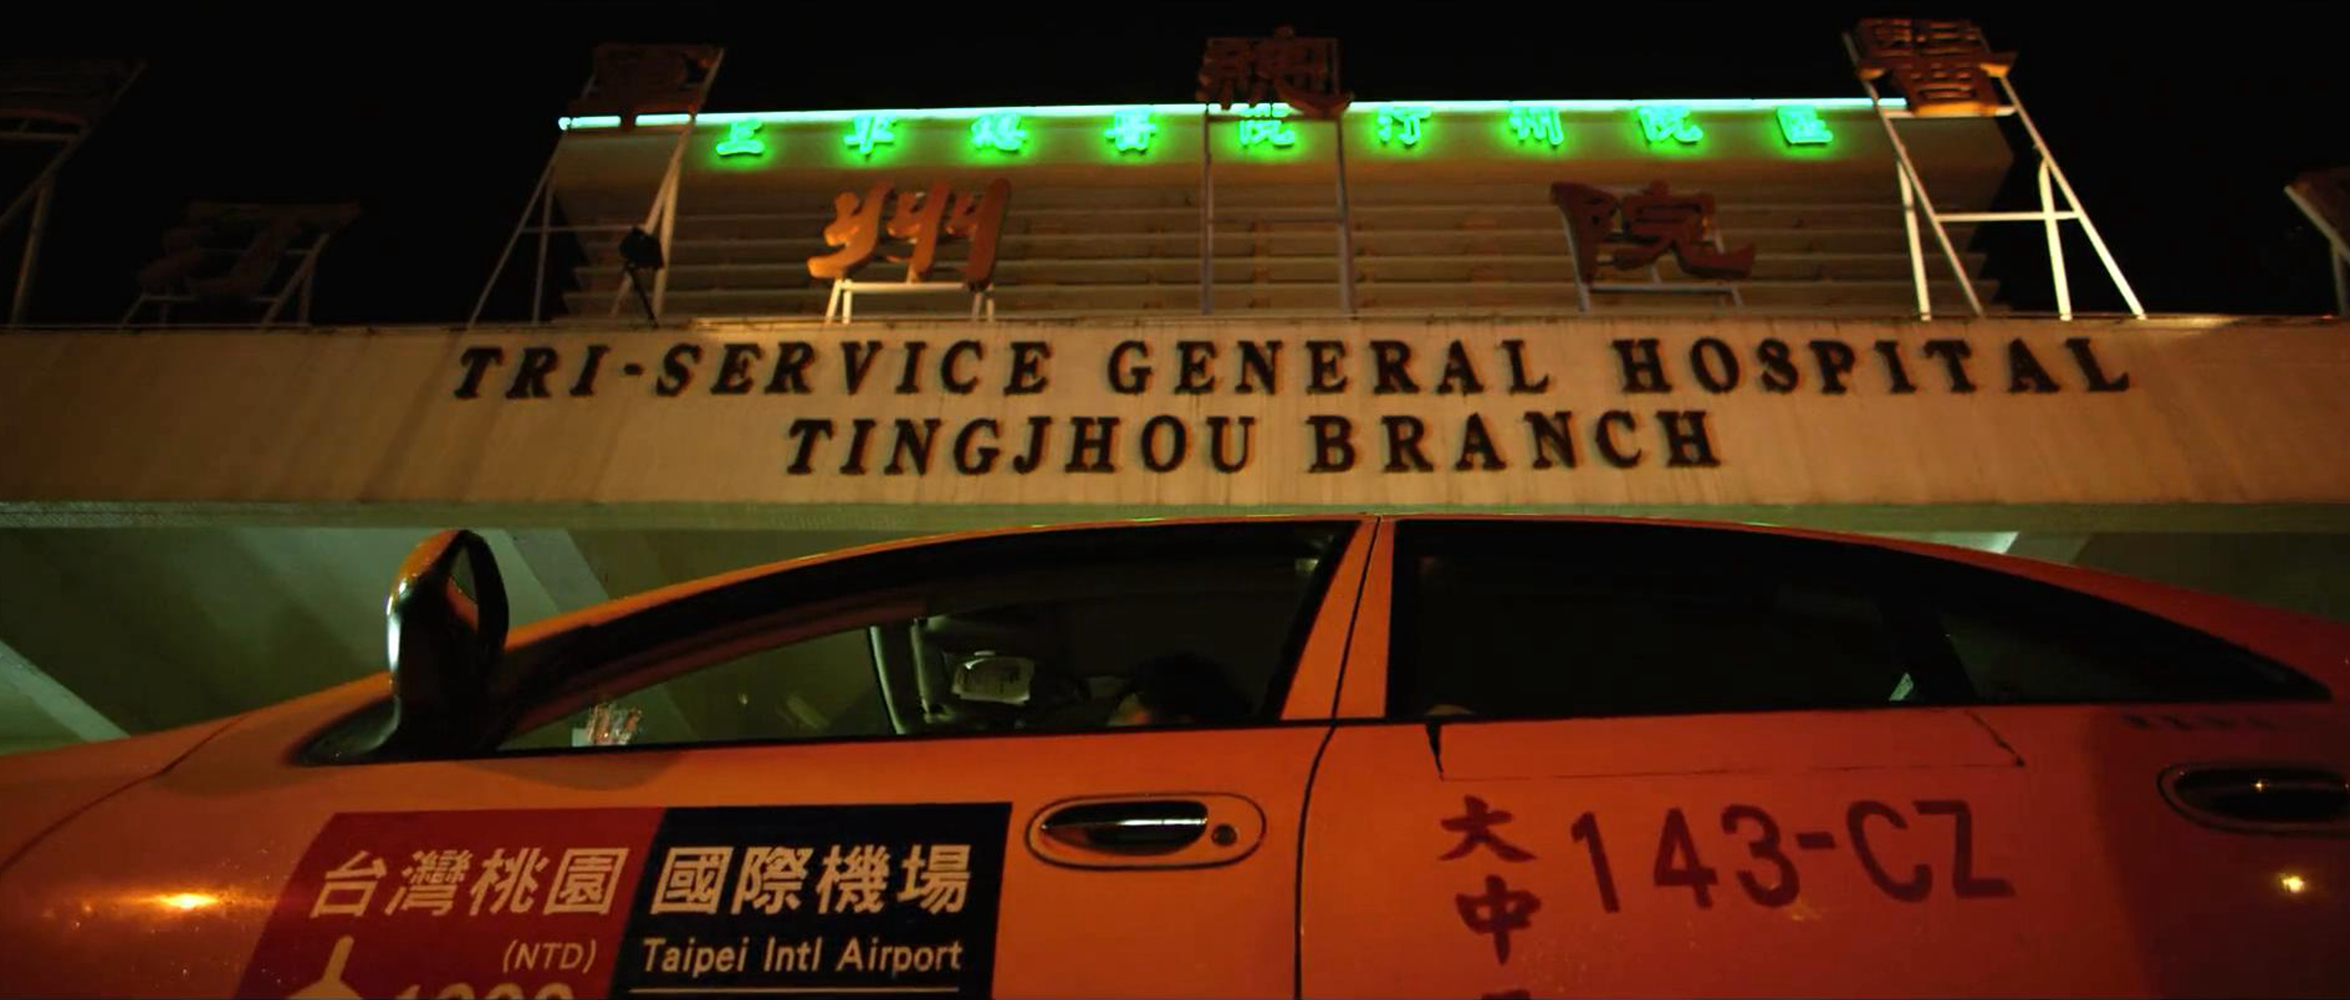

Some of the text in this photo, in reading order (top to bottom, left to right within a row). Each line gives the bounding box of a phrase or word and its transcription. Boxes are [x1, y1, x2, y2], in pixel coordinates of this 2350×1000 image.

[454, 337, 2131, 399] TRI-SERVICE GENERAL HOSPITAL
[787, 411, 1722, 474] TINGJHOU BRANCH
[1571, 800, 2016, 913] 143-CZ
[1439, 795, 1542, 1000] 大中
[502, 938, 598, 976] (NTD)
[641, 936, 965, 979] Taipei Intl Airport
